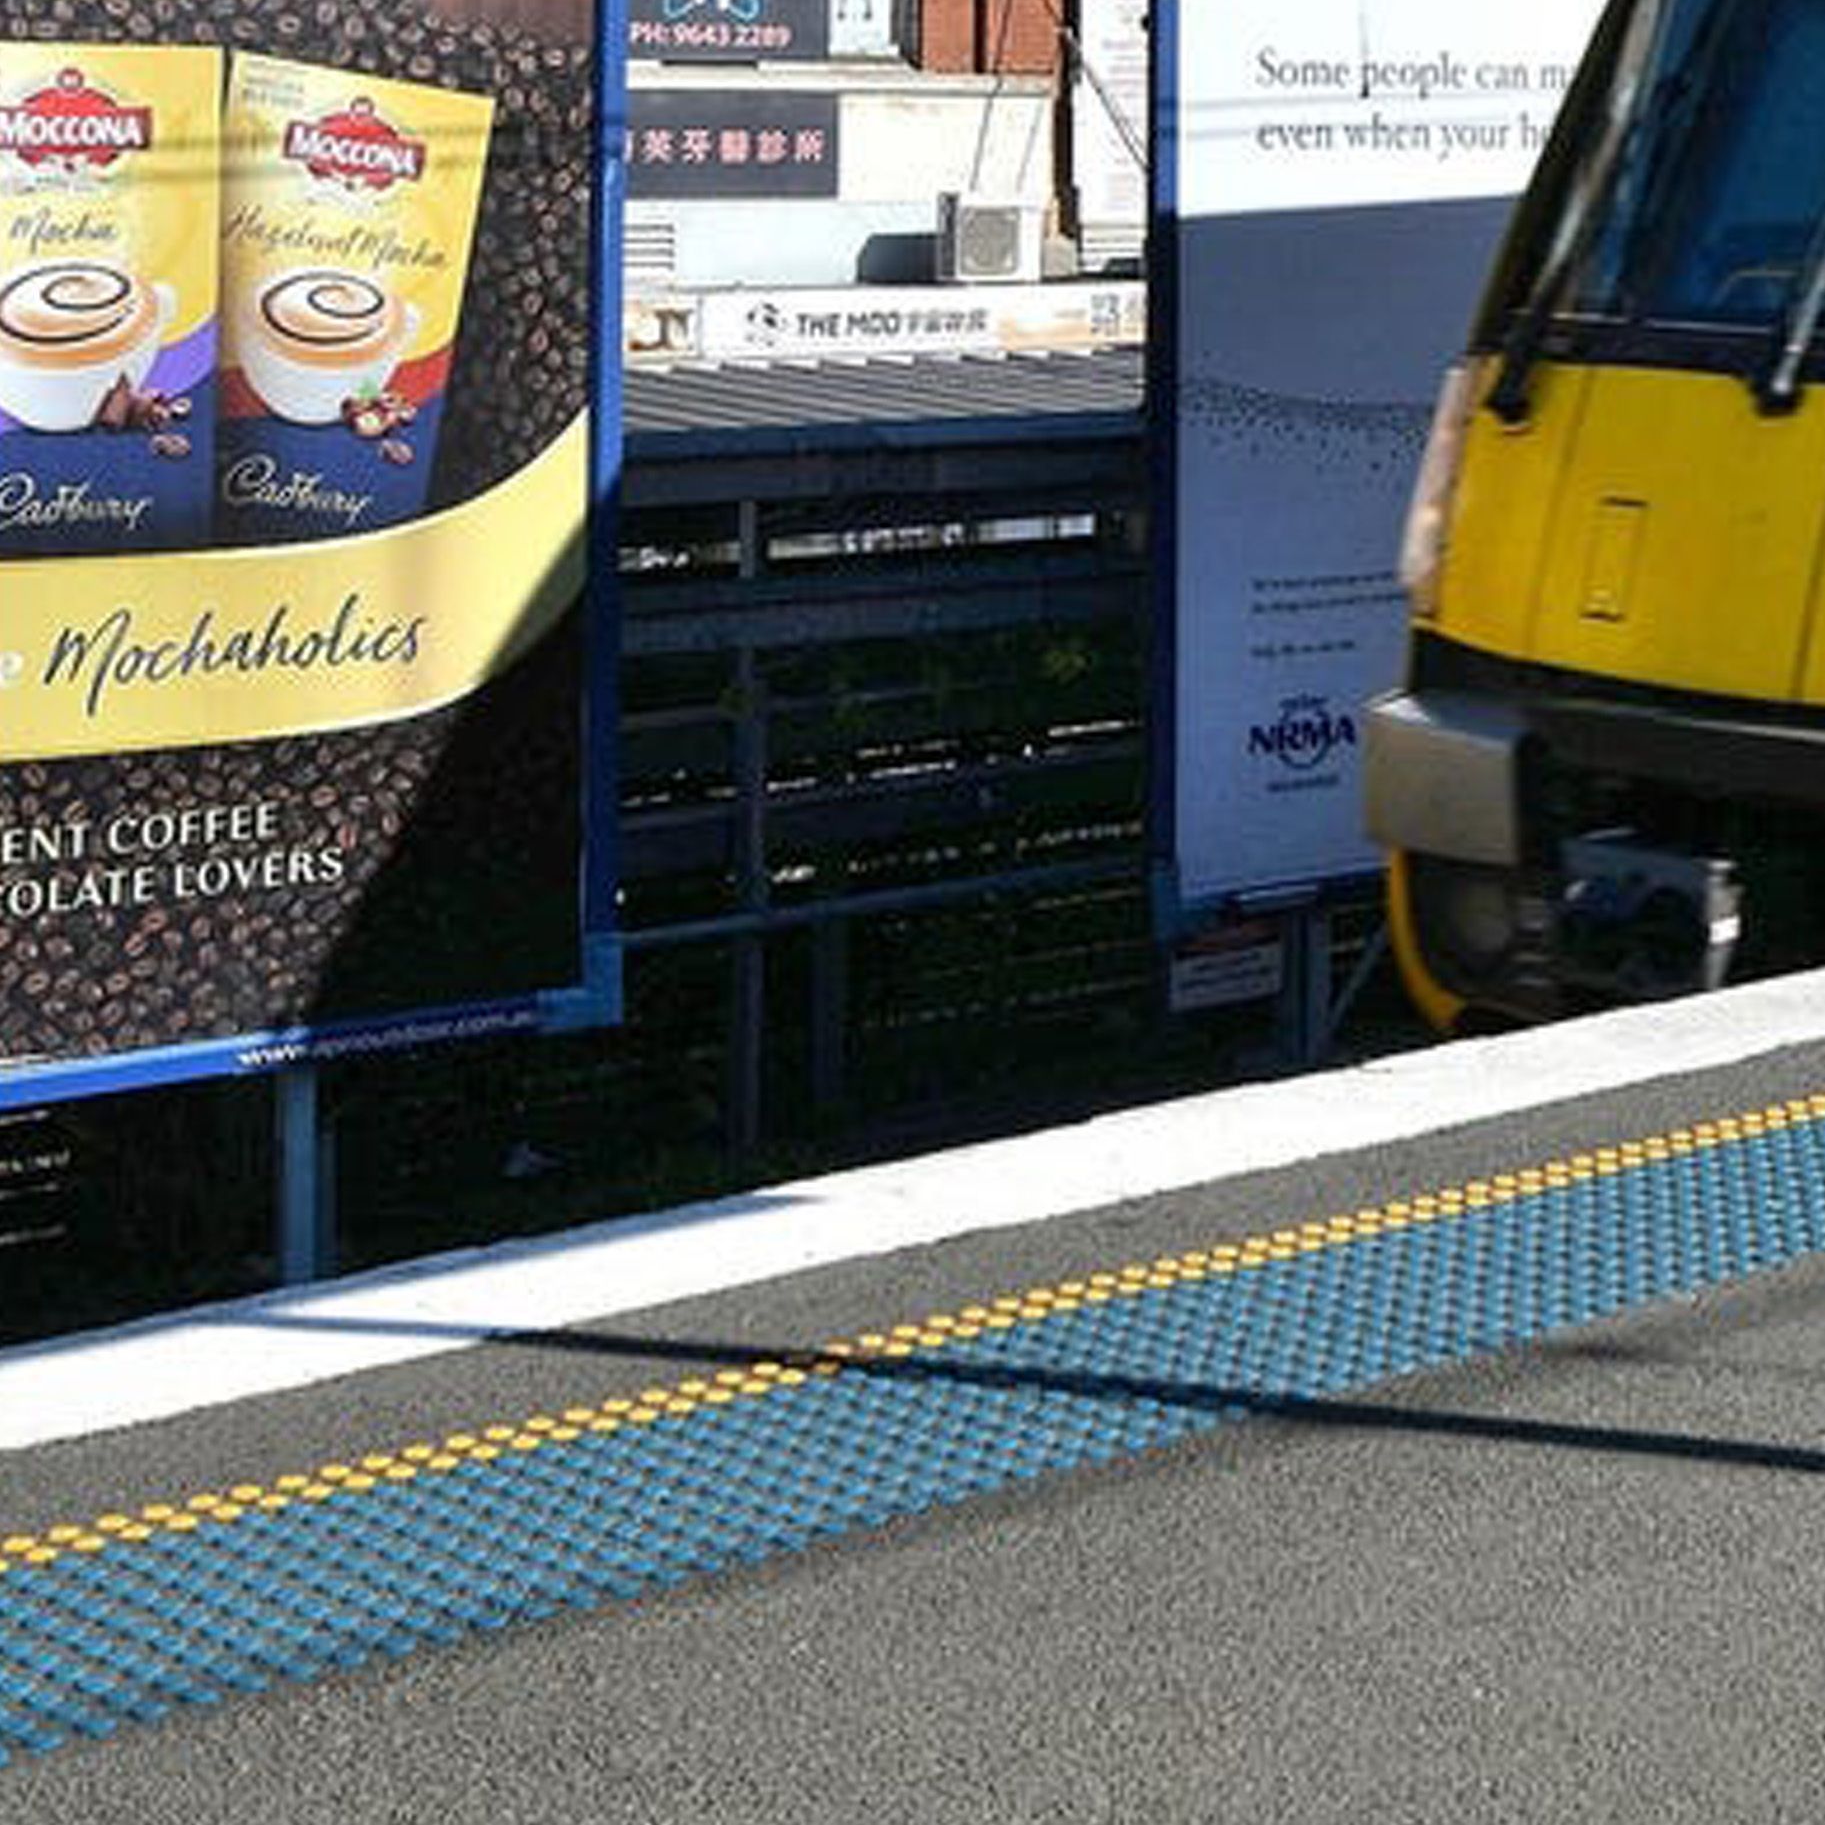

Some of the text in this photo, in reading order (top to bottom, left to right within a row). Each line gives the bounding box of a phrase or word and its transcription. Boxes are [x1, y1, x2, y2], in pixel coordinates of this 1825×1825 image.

[1256, 44, 1351, 91] Some
[1358, 51, 1467, 100] people
[1475, 61, 1530, 91] can
[289, 125, 417, 174] MOCCONA
[1256, 124, 1333, 151] even
[1343, 111, 1431, 151] when
[1440, 123, 1513, 163] your
[0, 473, 153, 531] Cadbury
[222, 453, 372, 527] Cadbury
[42, 593, 428, 717] Mochaholics
[1247, 713, 1357, 756] NRMA
[107, 800, 280, 855] COFFEE
[0, 846, 345, 917] OLATE LOVERS
